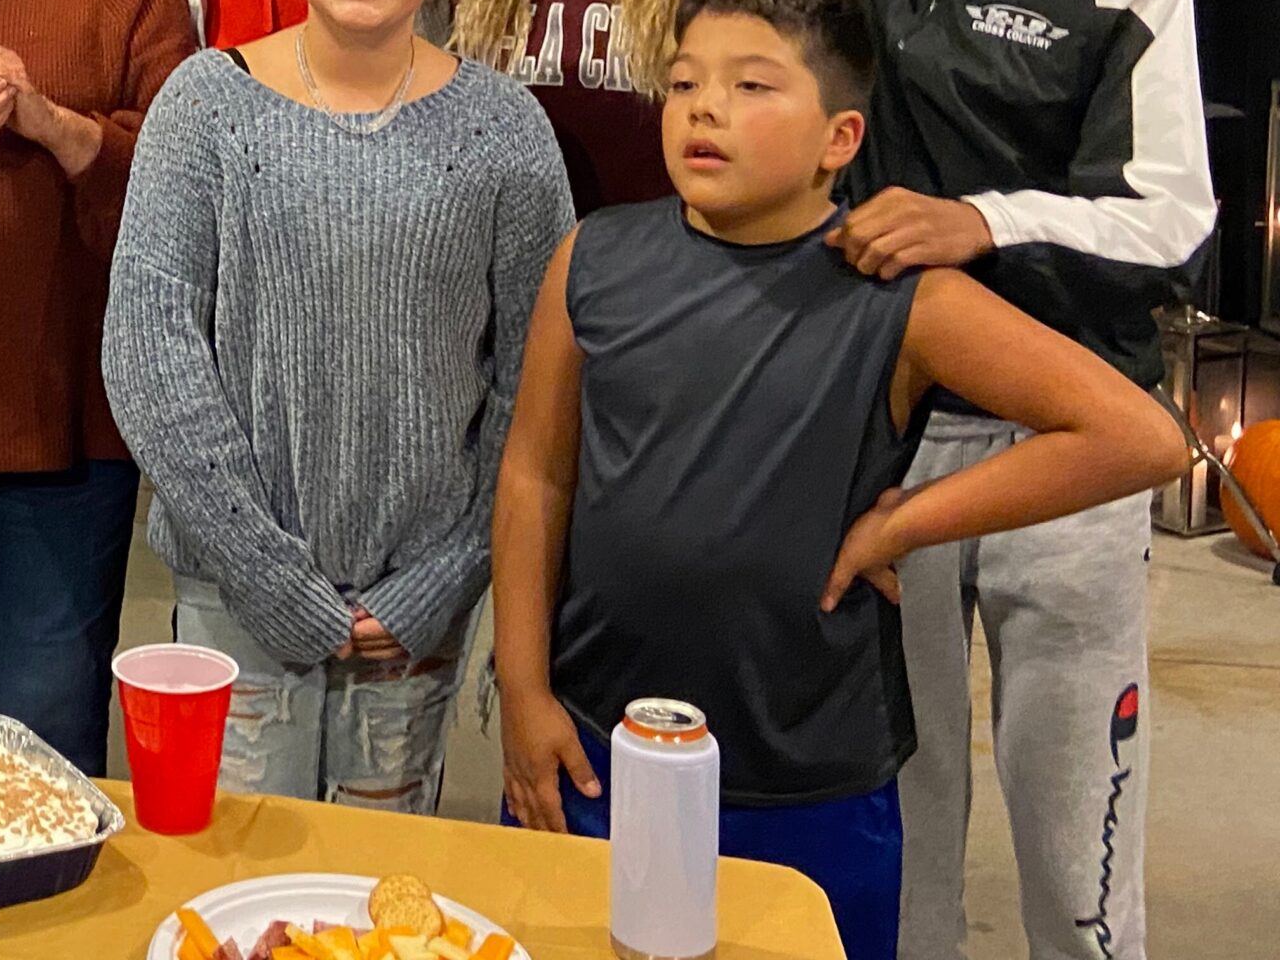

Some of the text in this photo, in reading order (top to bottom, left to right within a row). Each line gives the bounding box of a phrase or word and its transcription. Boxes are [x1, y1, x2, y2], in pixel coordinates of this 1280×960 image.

[578, 2, 650, 93] CR
[972, 20, 1053, 51] CROSS COUNTRY
